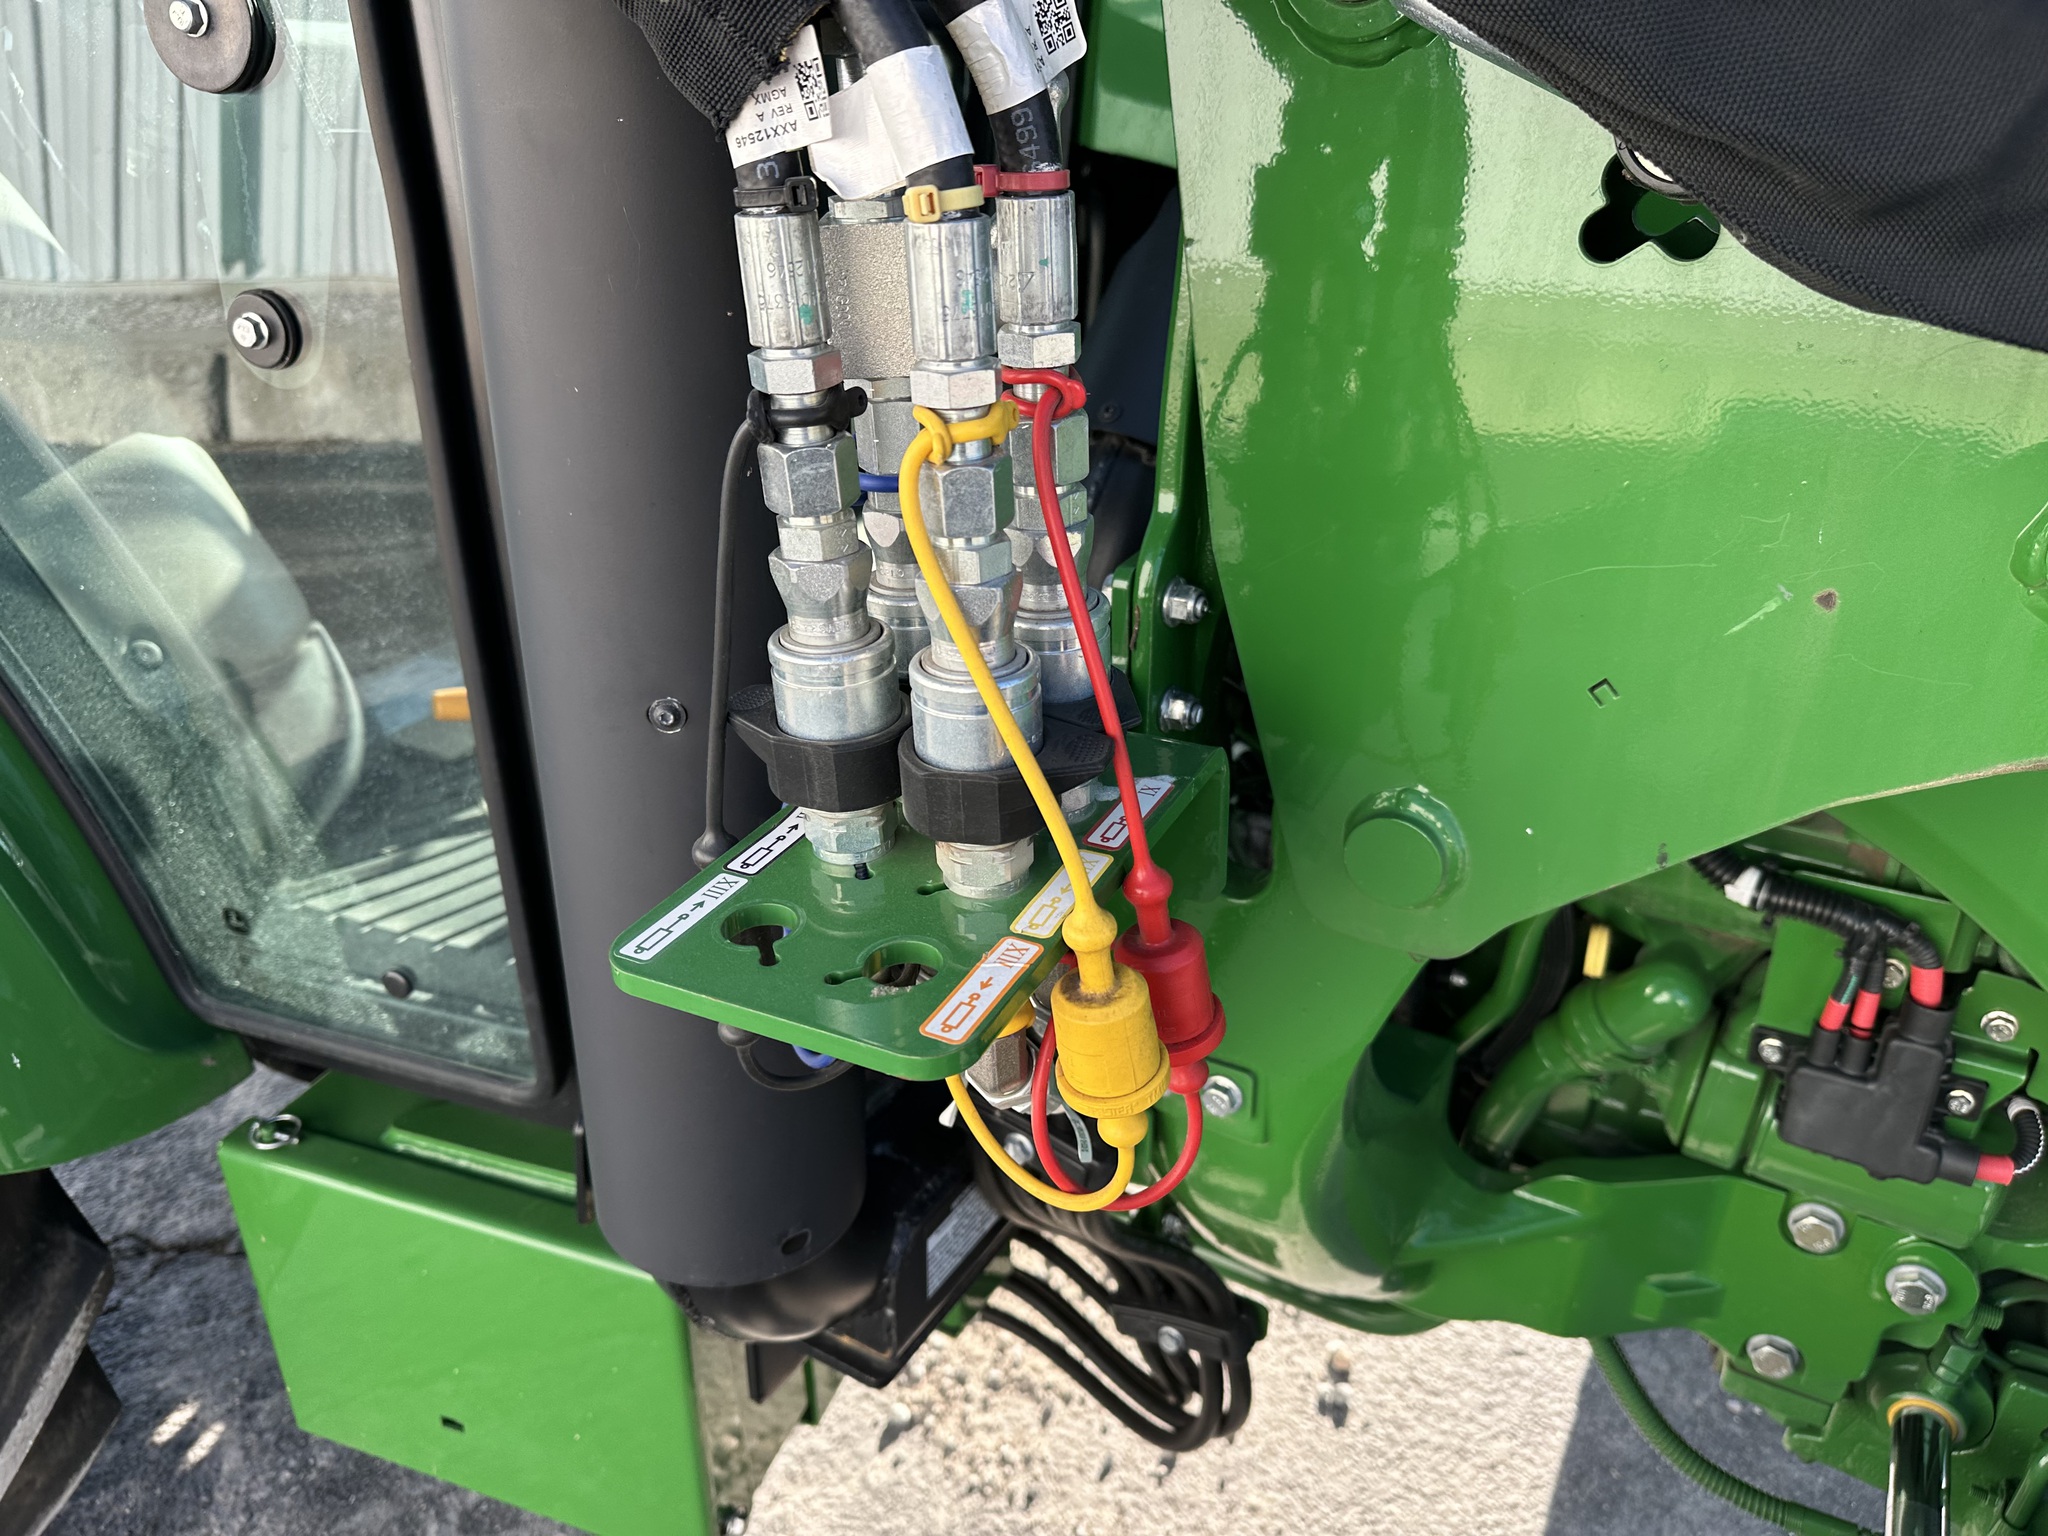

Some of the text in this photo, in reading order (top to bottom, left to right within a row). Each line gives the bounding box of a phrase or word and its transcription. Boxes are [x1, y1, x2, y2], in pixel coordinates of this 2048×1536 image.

[755, 103, 793, 122] REV A
[735, 119, 798, 148] AXX12546
